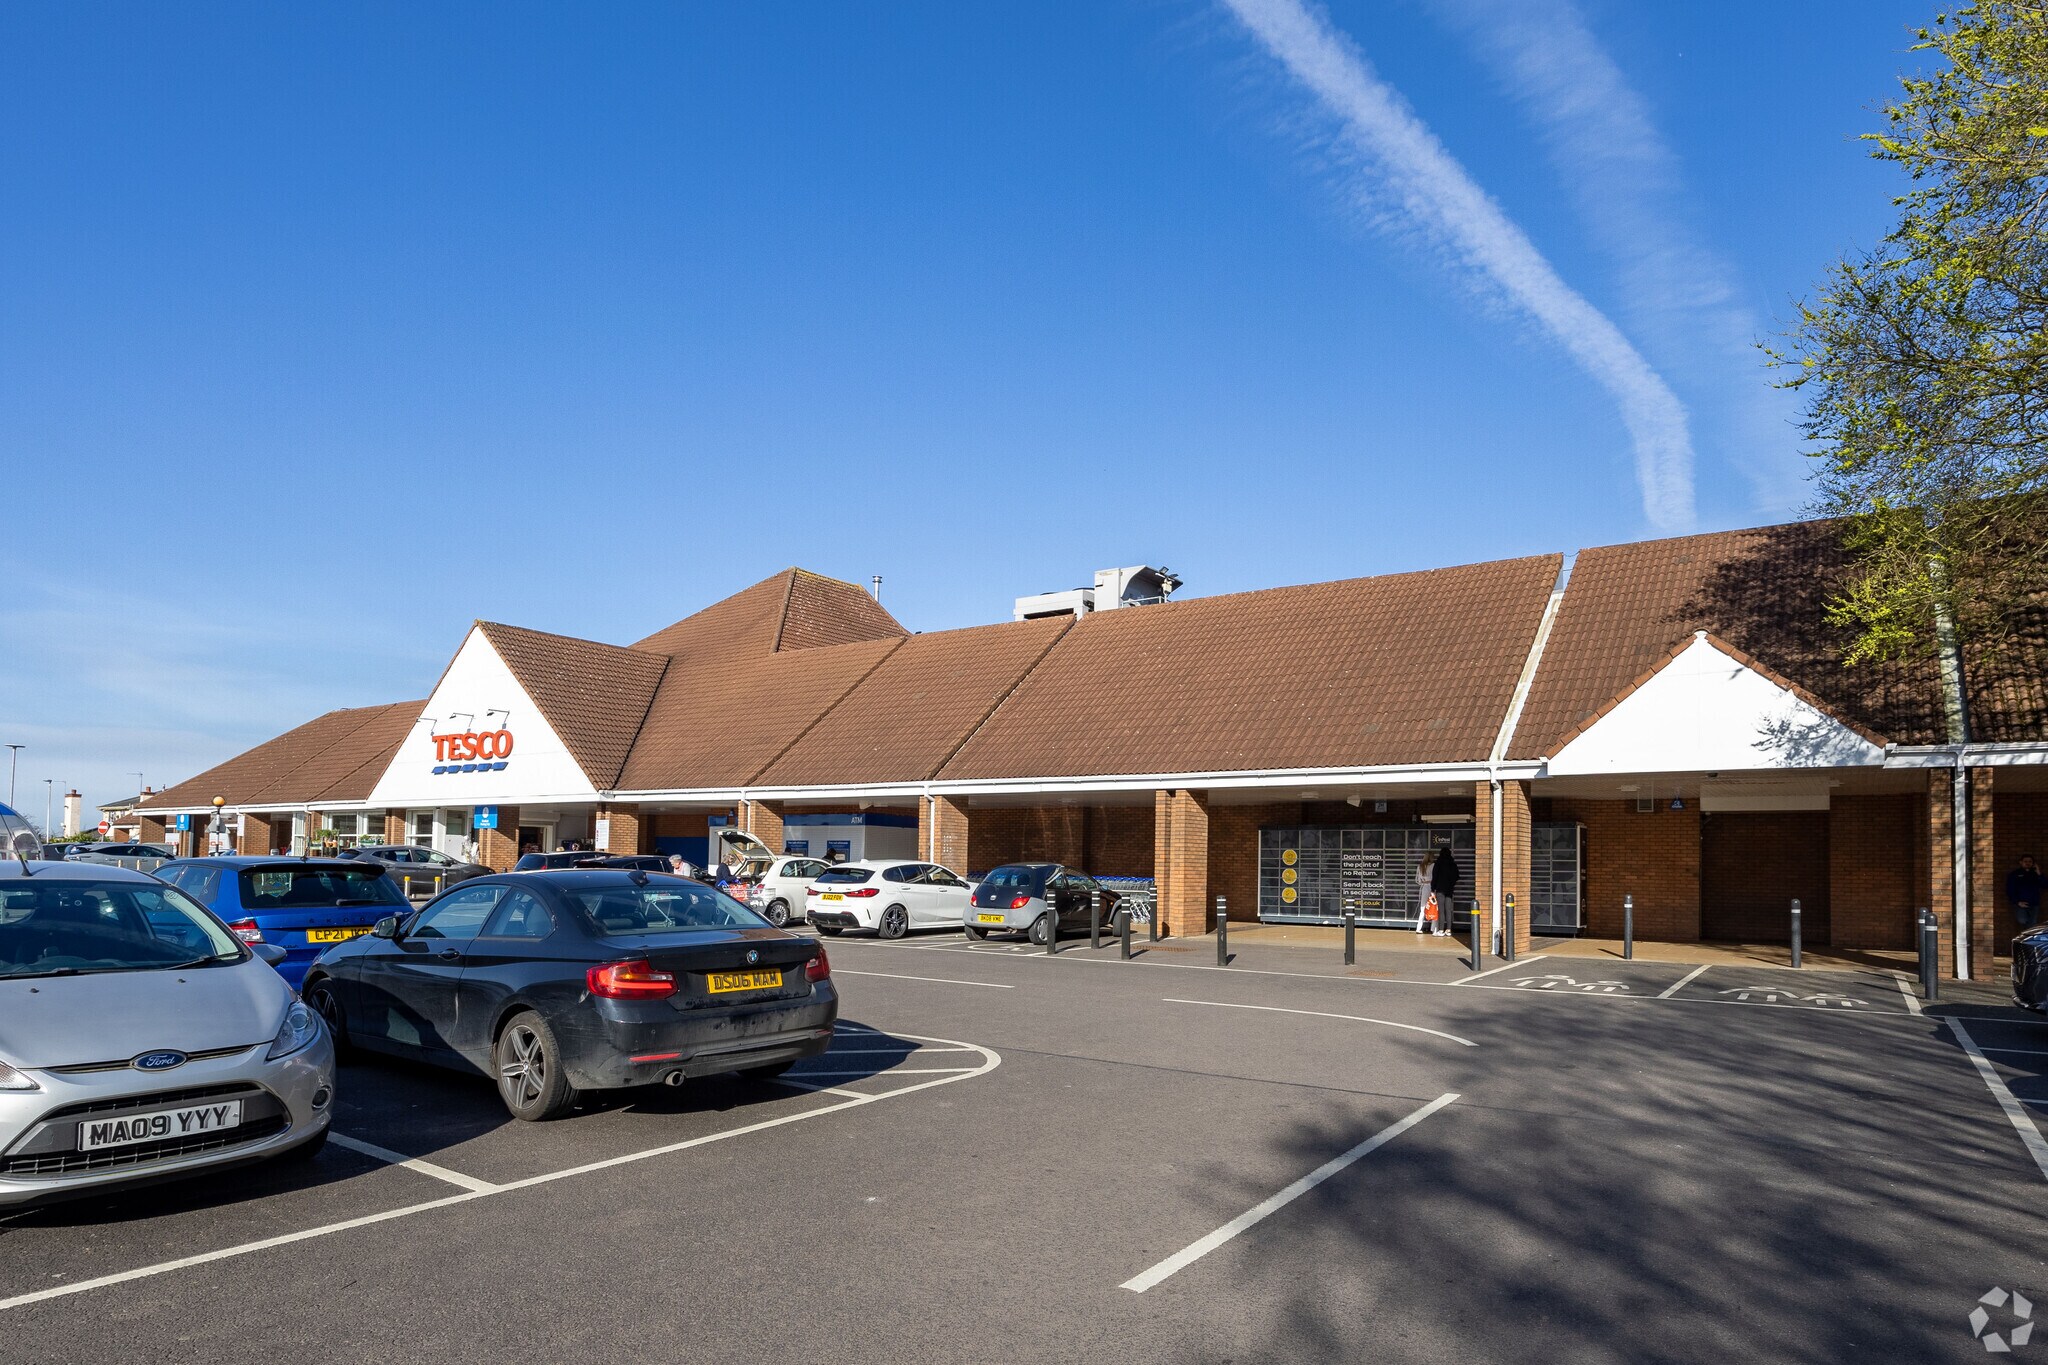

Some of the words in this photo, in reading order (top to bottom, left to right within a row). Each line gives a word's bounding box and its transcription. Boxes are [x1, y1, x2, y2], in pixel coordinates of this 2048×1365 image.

[432, 730, 514, 762] TESCO
[851, 816, 863, 824] ATM
[315, 928, 345, 941] CP21
[713, 974, 751, 990] DS06
[752, 971, 779, 987] MAM
[146, 1055, 176, 1067] Ford
[90, 1115, 172, 1146] MA09
[177, 1105, 232, 1133] YYY
